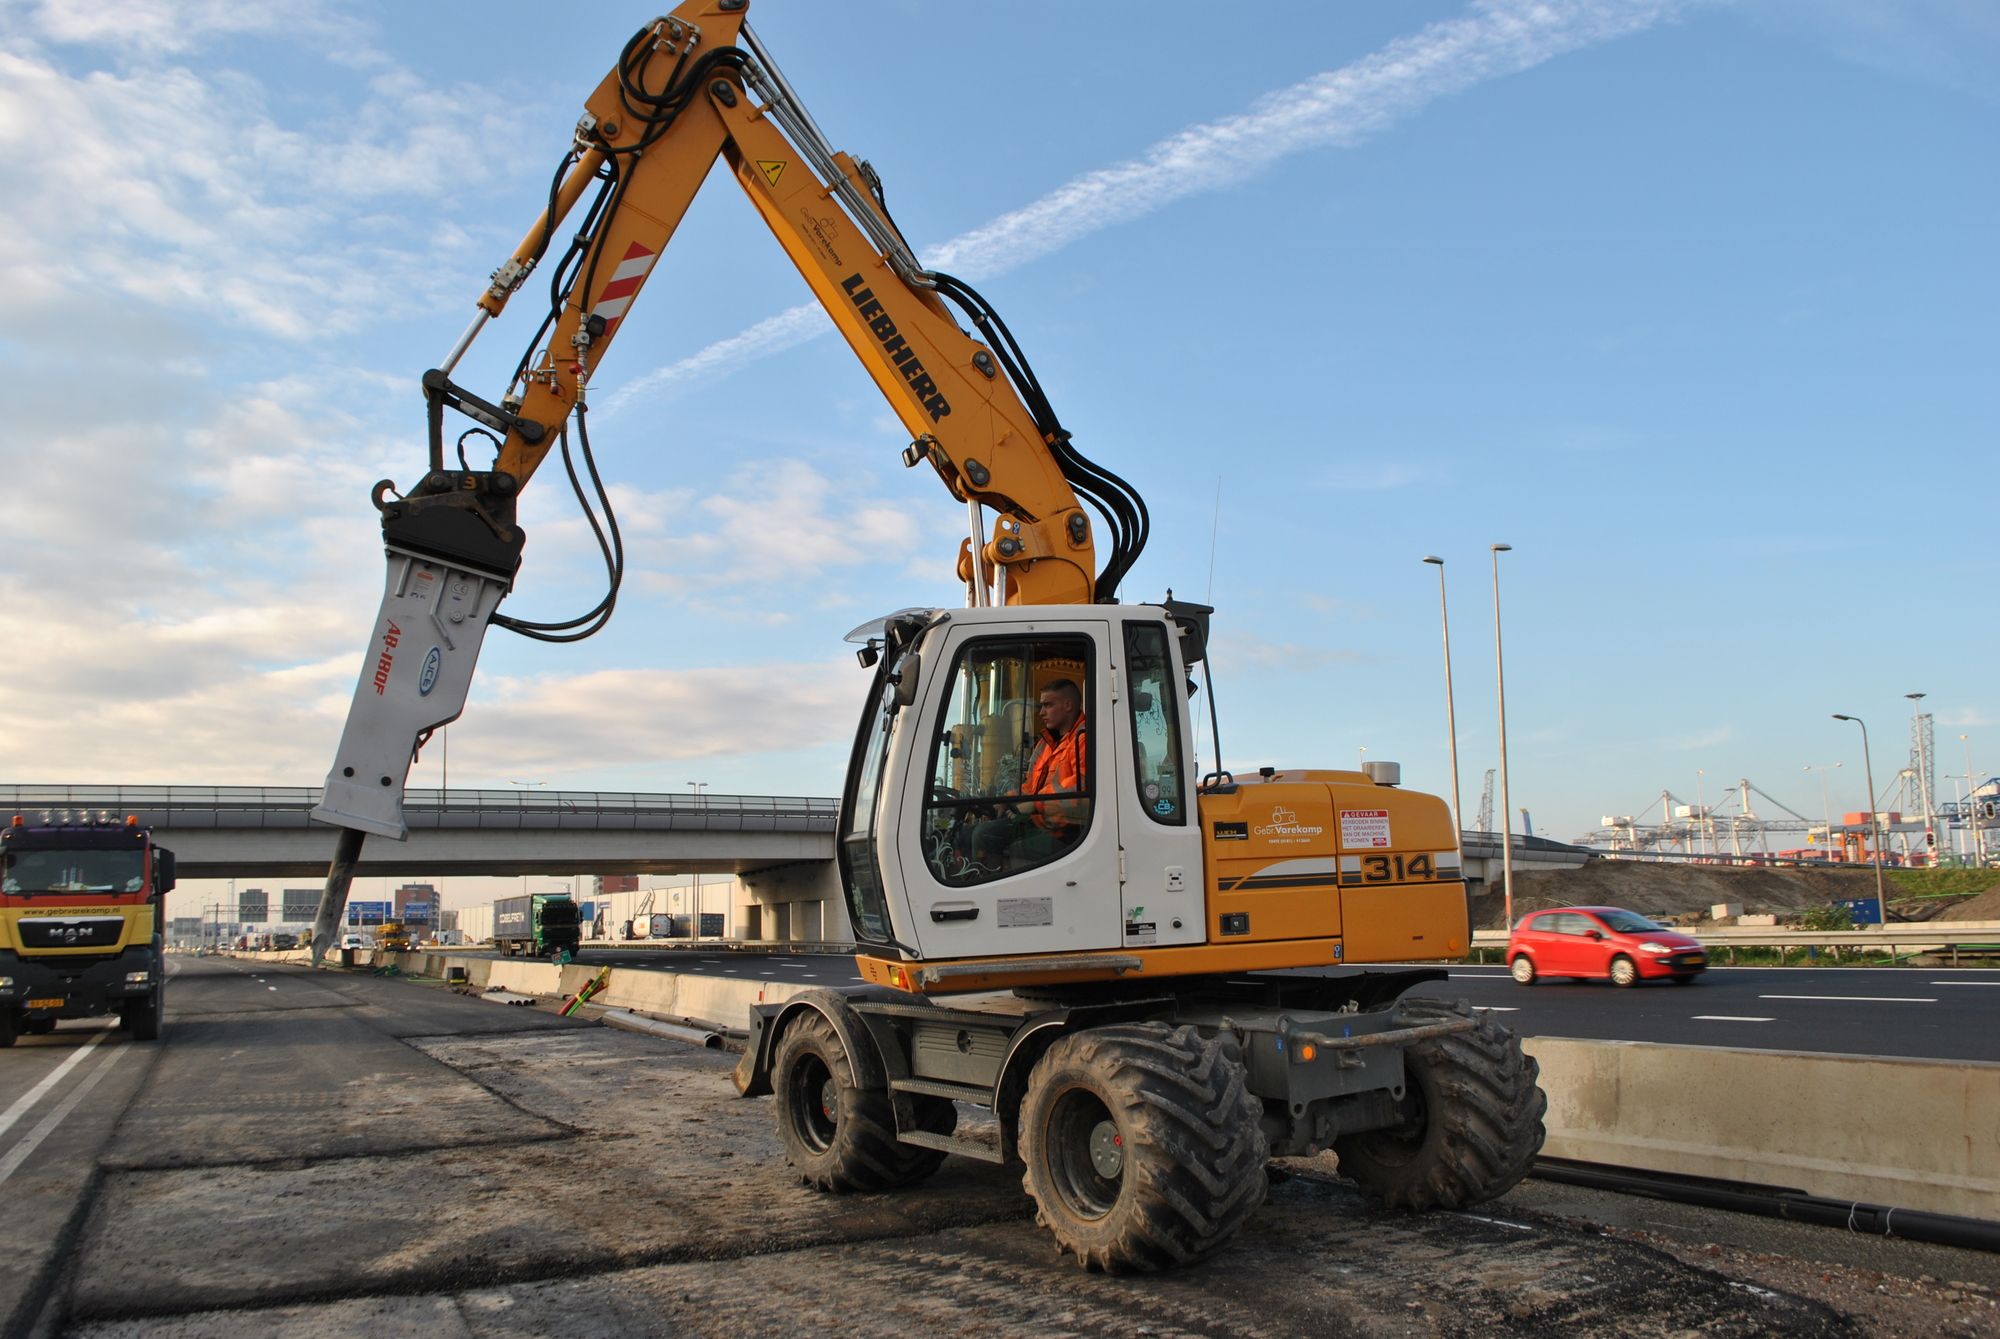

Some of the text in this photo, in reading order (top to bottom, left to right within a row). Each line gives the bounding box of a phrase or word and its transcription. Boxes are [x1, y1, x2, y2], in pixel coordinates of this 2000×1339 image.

[841, 273, 951, 424] LIEBHERR
[374, 619, 401, 695] AB-180F
[1364, 853, 1434, 881] 314
[24, 907, 120, 916] www.gebrvarekamp.nl
[49, 927, 93, 937] MAN
